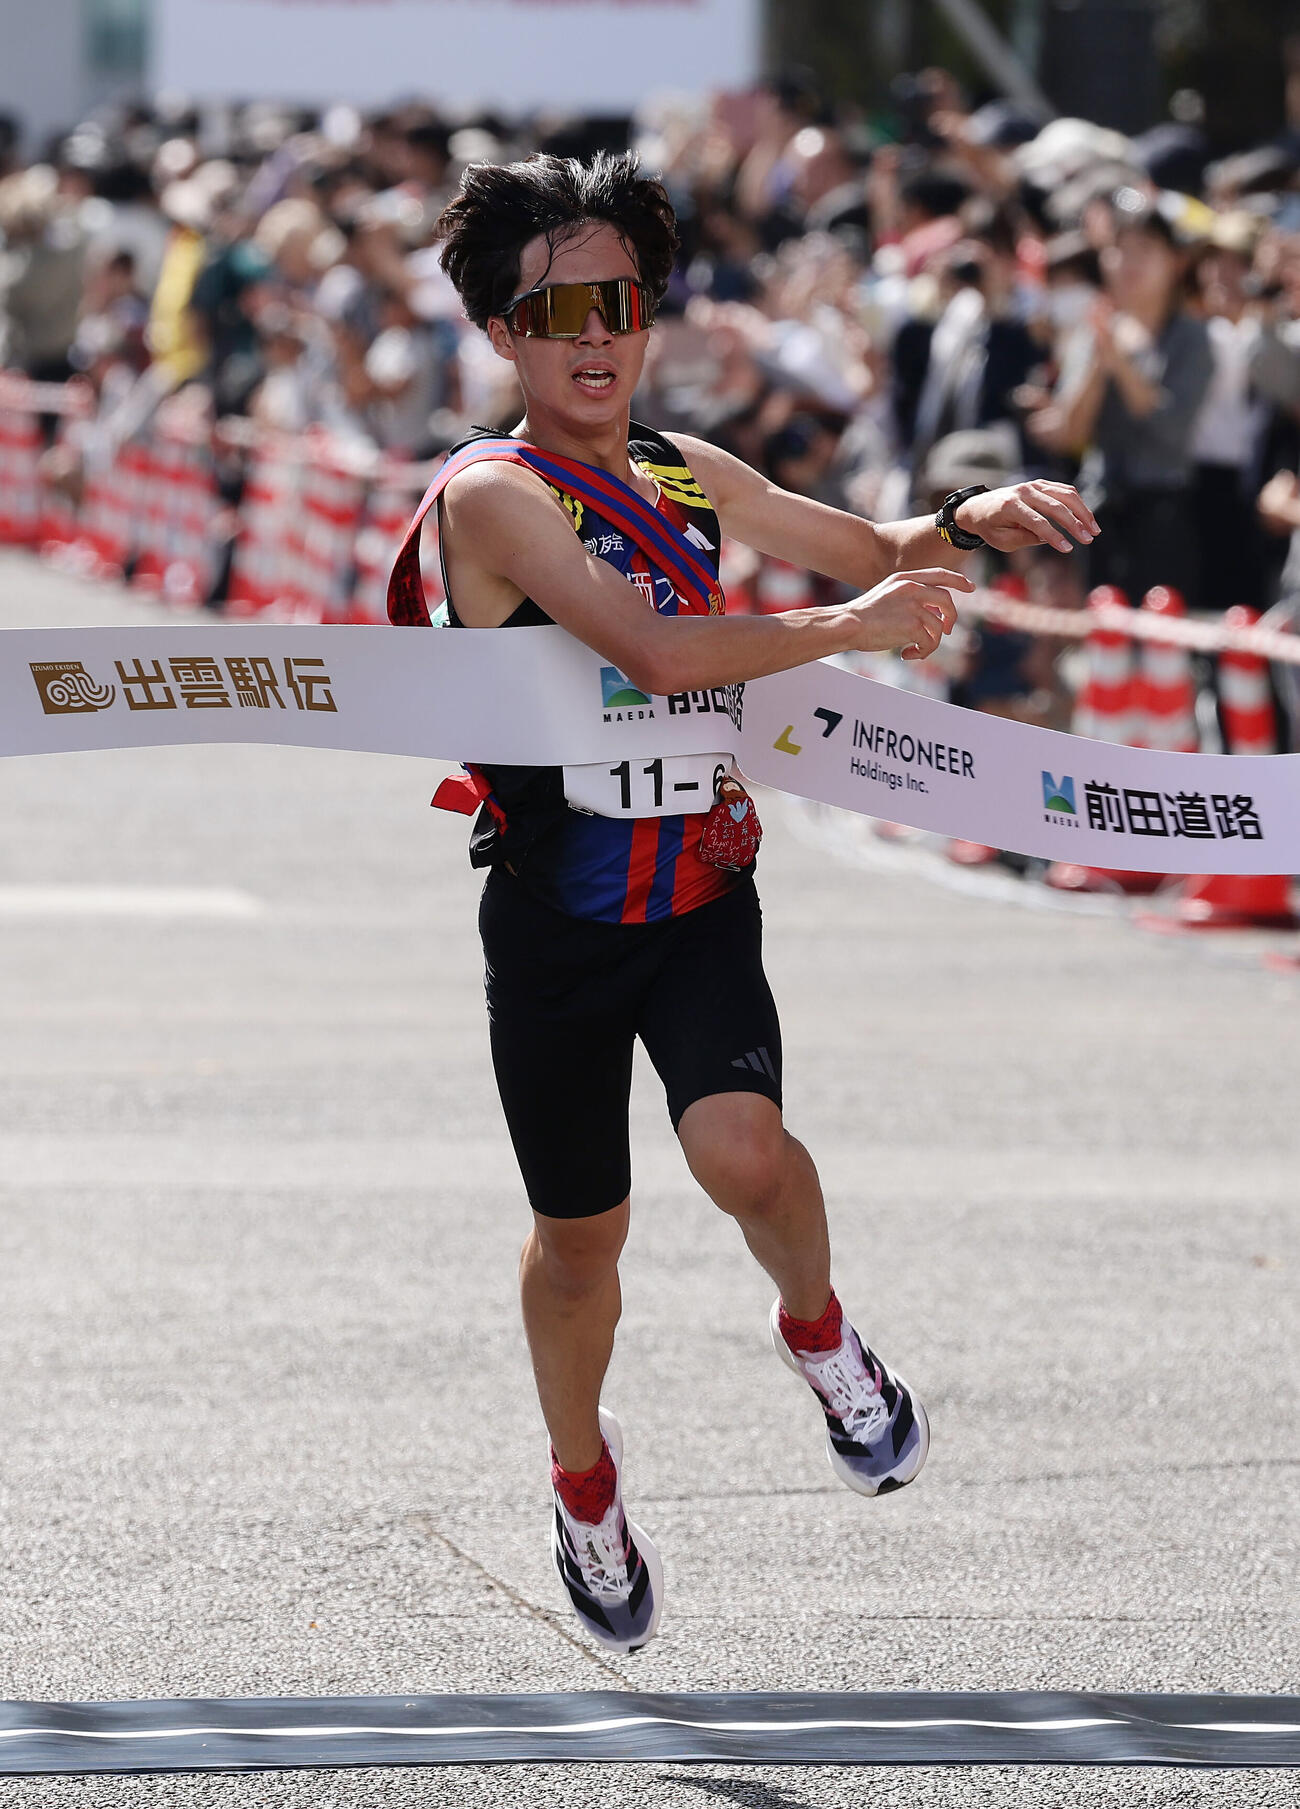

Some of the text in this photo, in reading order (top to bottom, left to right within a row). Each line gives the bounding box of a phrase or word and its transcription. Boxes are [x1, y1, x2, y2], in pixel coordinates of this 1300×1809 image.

[113, 656, 339, 712] 出雲駅伝
[603, 709, 655, 722] MAEDA
[850, 756, 930, 794] Holdings Inc.
[852, 719, 976, 779] INFRONEER
[1084, 779, 1264, 840] 前田道路
